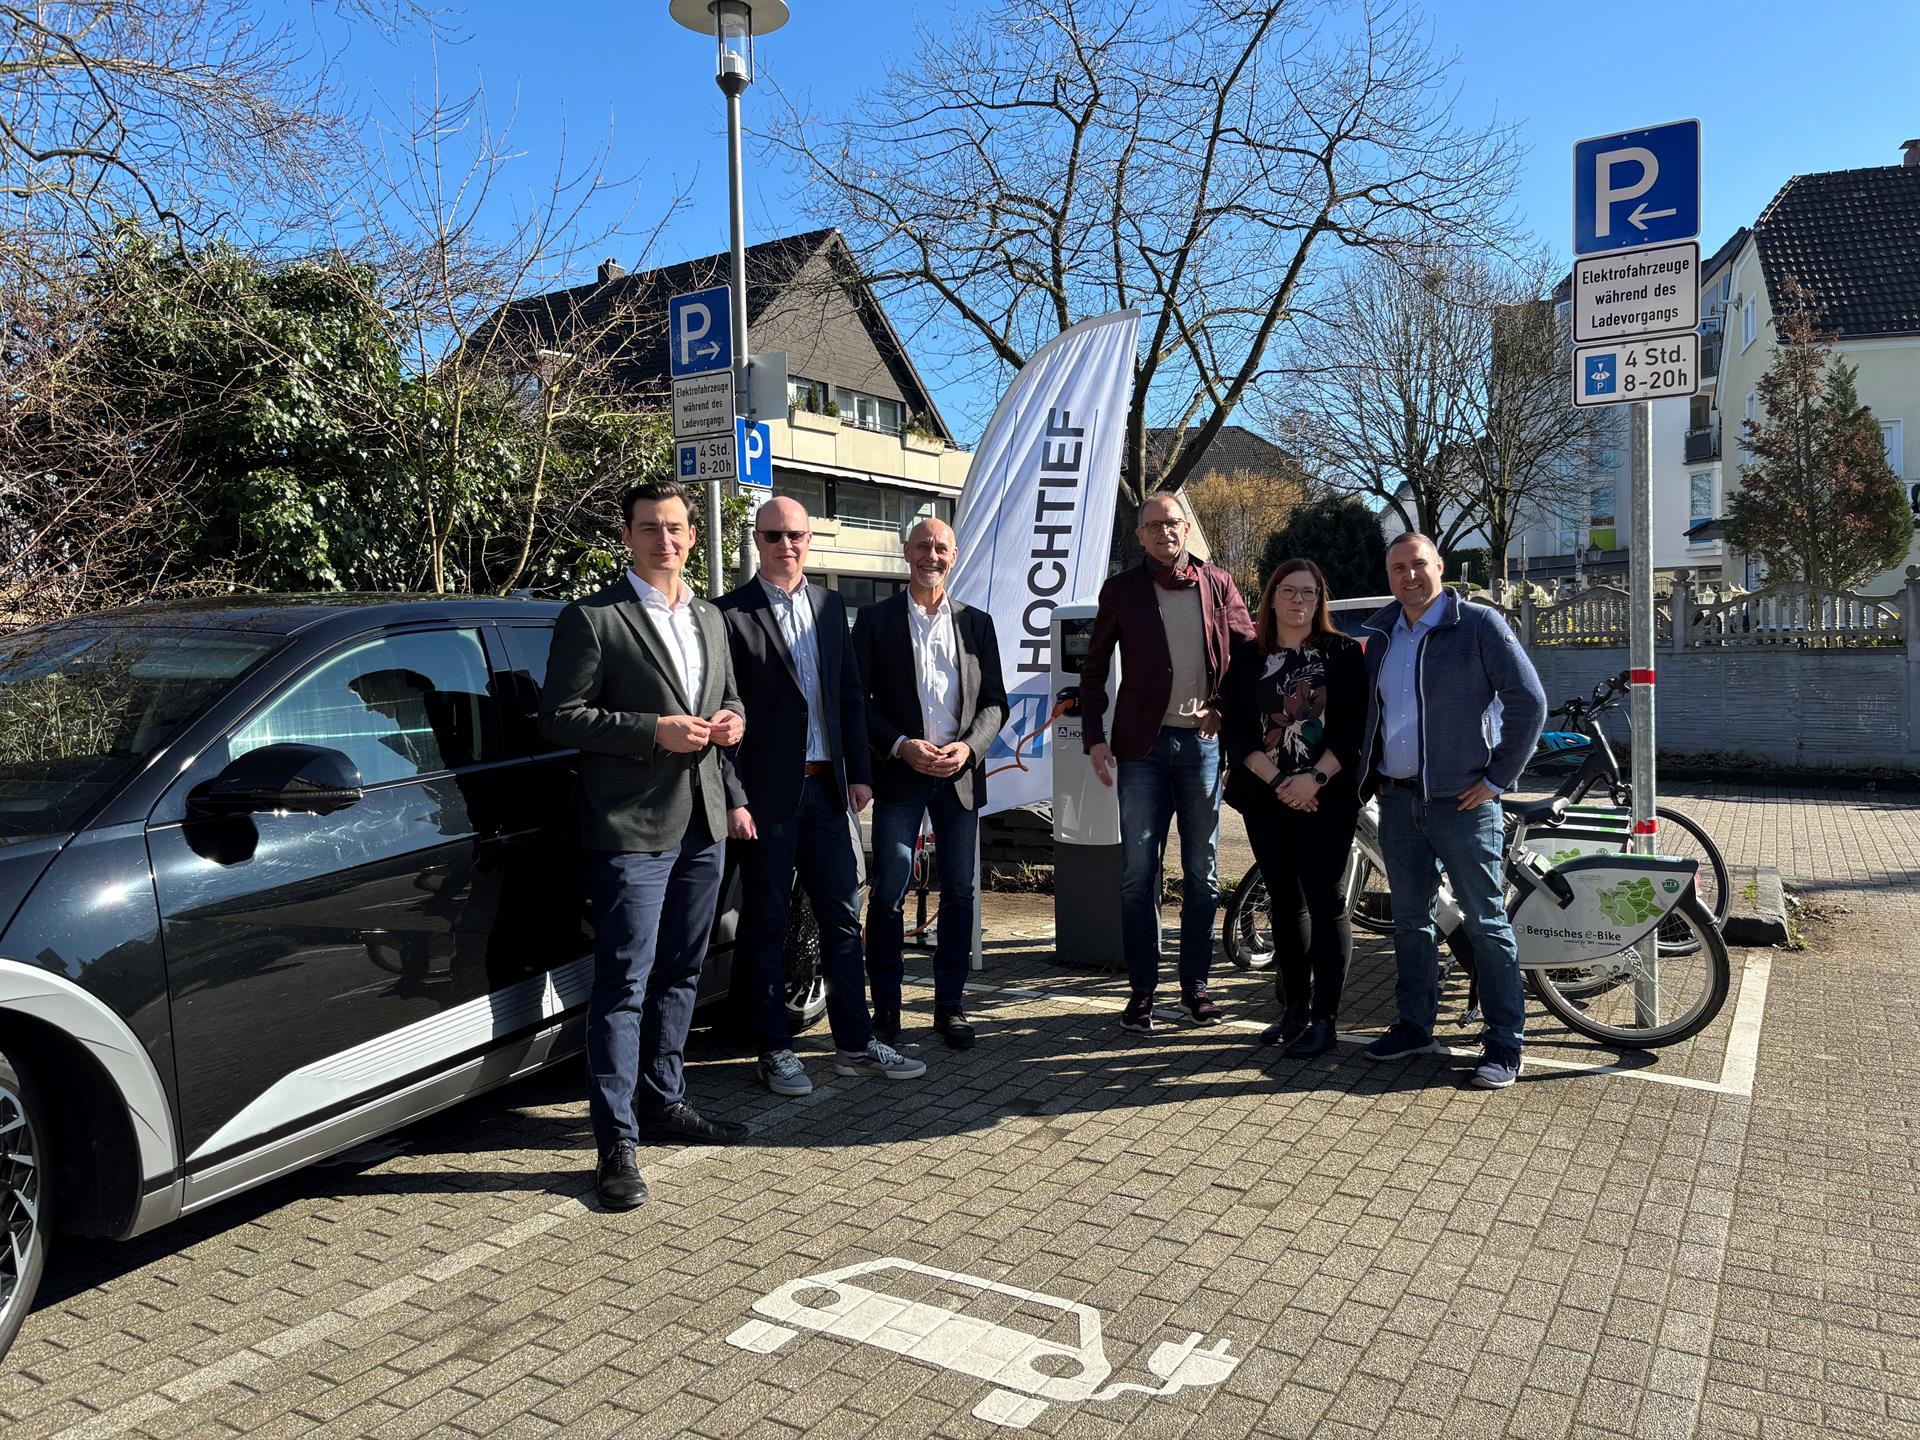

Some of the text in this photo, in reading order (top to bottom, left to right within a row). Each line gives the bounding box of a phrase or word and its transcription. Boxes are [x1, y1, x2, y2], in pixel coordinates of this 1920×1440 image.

[1595, 146, 1659, 238] P
[1582, 259, 1690, 285] Elektrofahrzeuge
[1595, 283, 1677, 305] während des
[1591, 307, 1679, 329] Ladevorgangs
[679, 302, 712, 365] P
[1625, 344, 1687, 368] 4 Std.
[676, 383, 729, 398] Elektrofahrzeuge
[1624, 368, 1687, 392] 8-20h
[683, 399, 723, 412] während des
[682, 416, 725, 429] Ladevorgangs
[700, 443, 730, 458] 4 Std.
[744, 426, 763, 476] P
[700, 459, 731, 474] 8-20h
[1016, 407, 1085, 673] HOCHTIEF
[1527, 925, 1622, 941] Bergisches e-Bike
